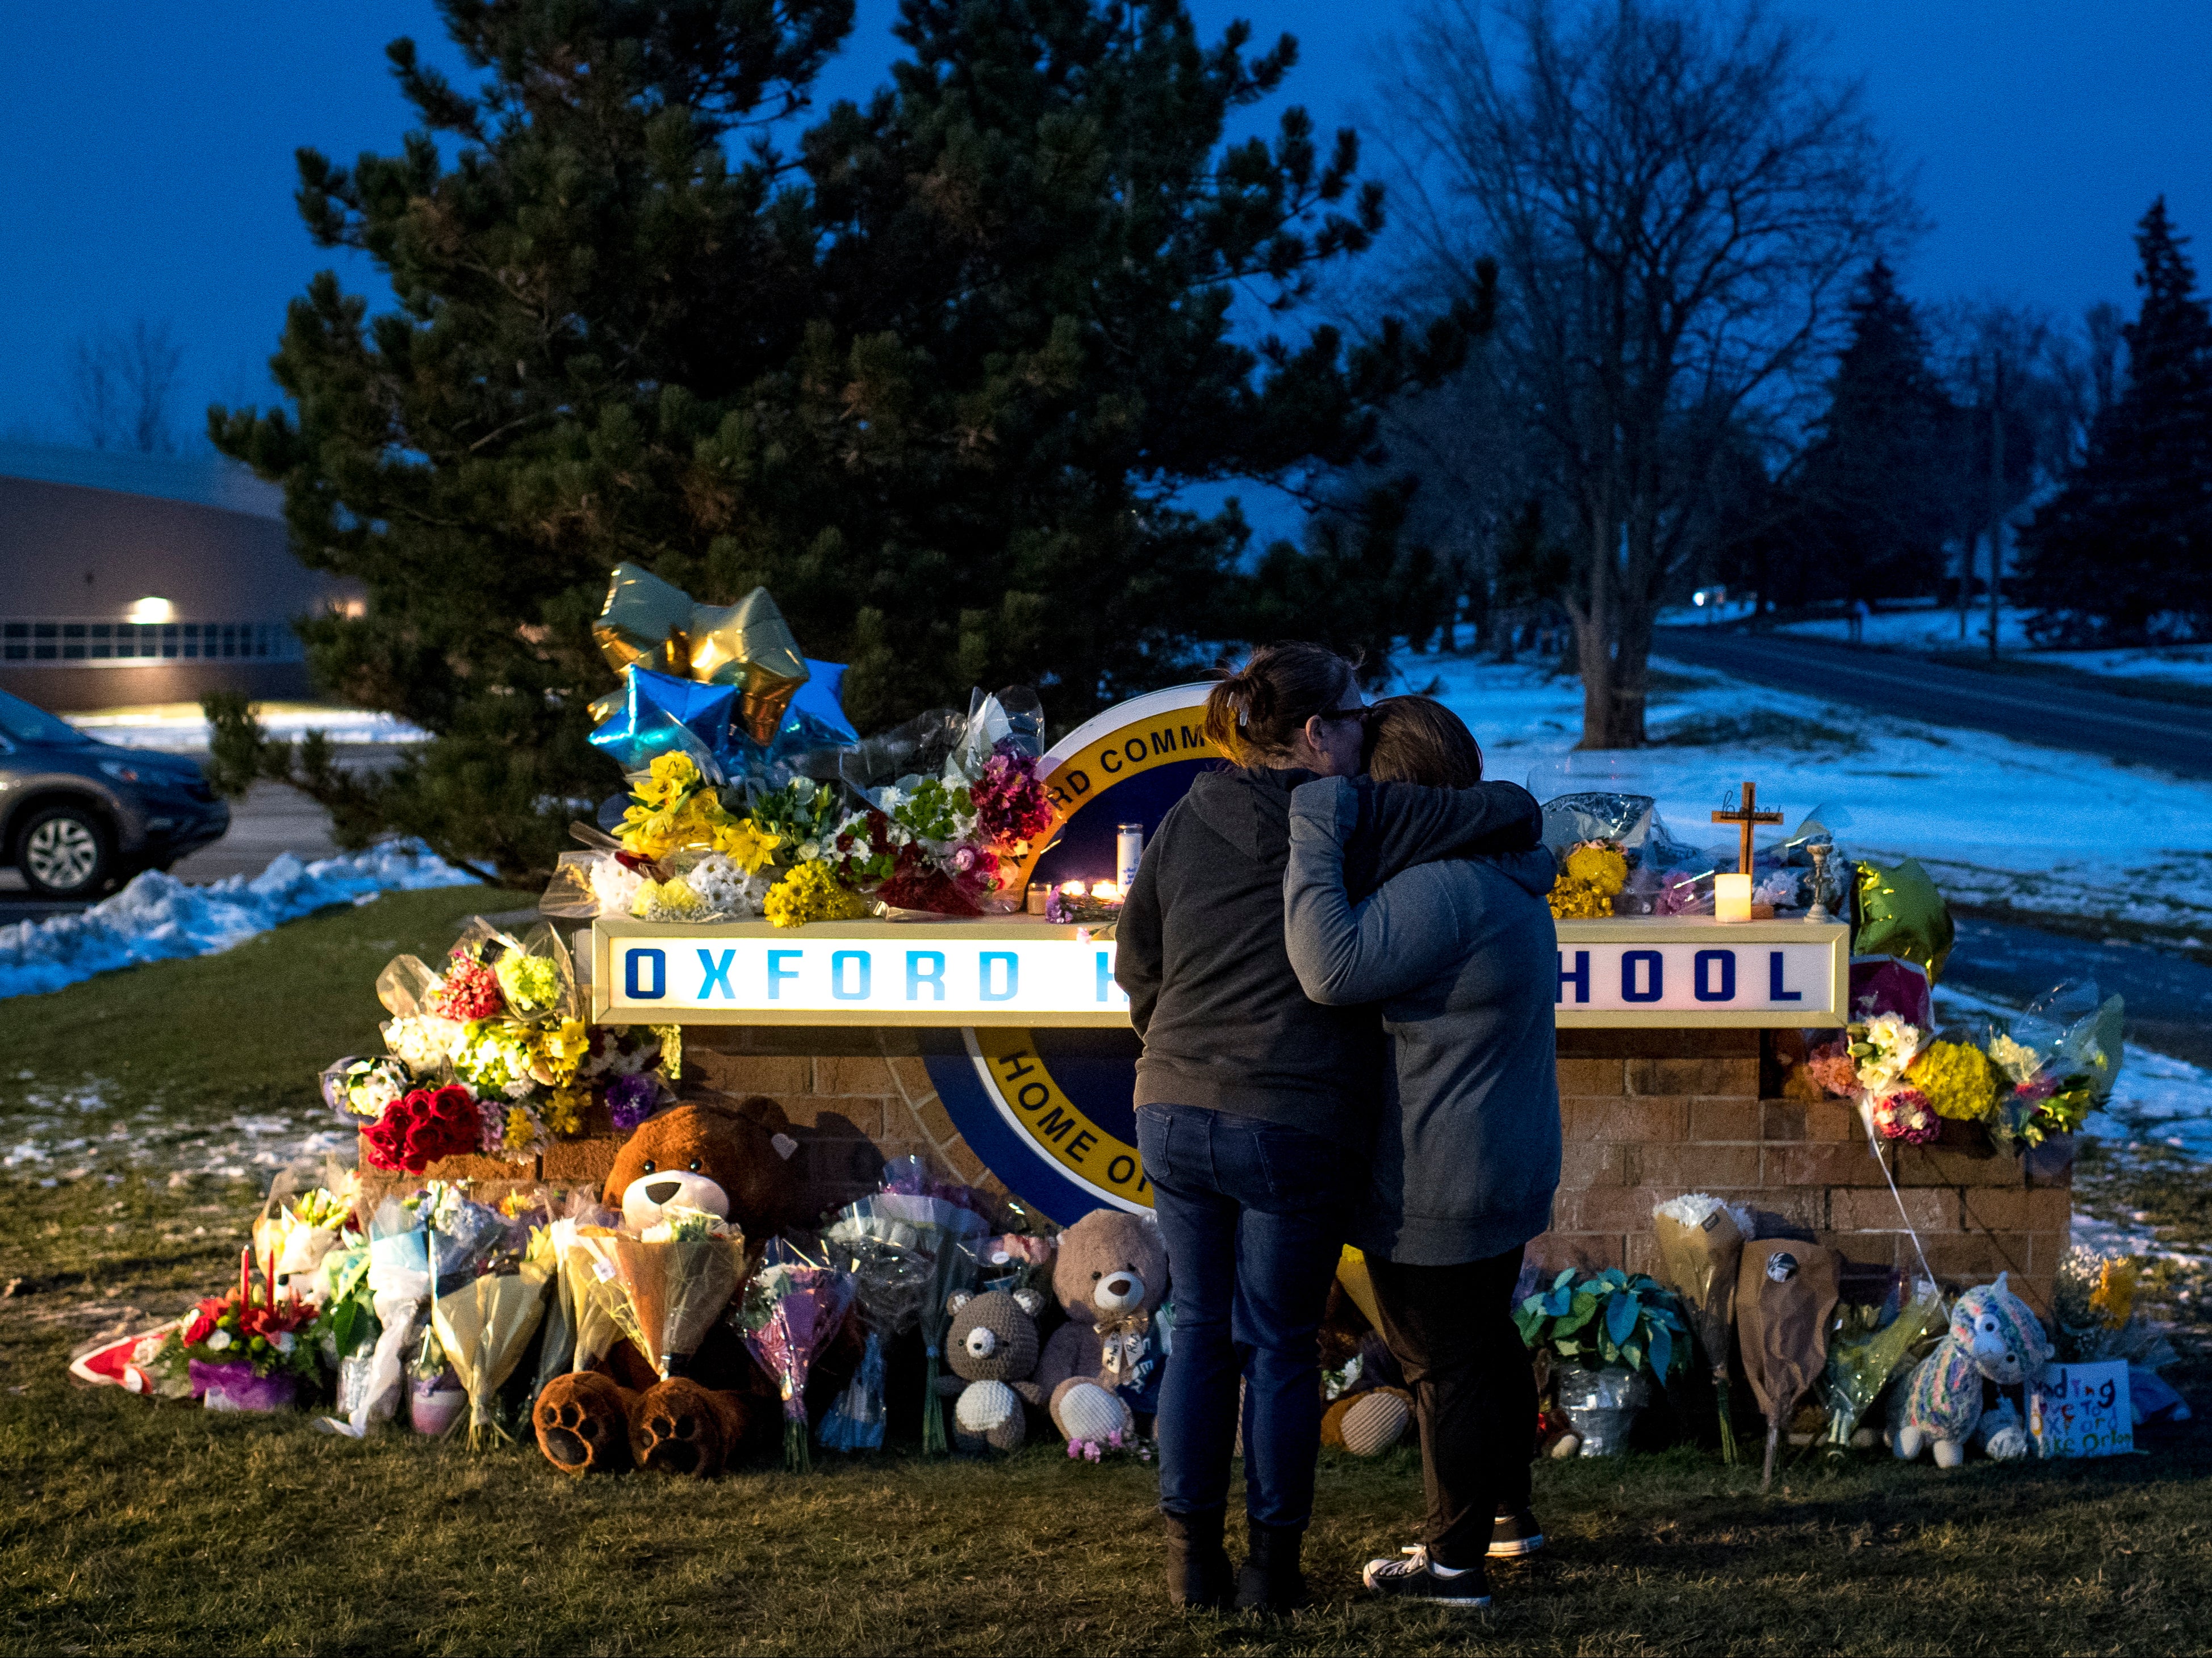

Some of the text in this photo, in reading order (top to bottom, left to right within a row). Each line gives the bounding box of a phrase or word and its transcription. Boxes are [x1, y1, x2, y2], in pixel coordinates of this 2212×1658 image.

[625, 948, 1018, 1002] OXFORD
[1555, 949, 1802, 1003] HOOL
[998, 1050, 1098, 1163] HOME
